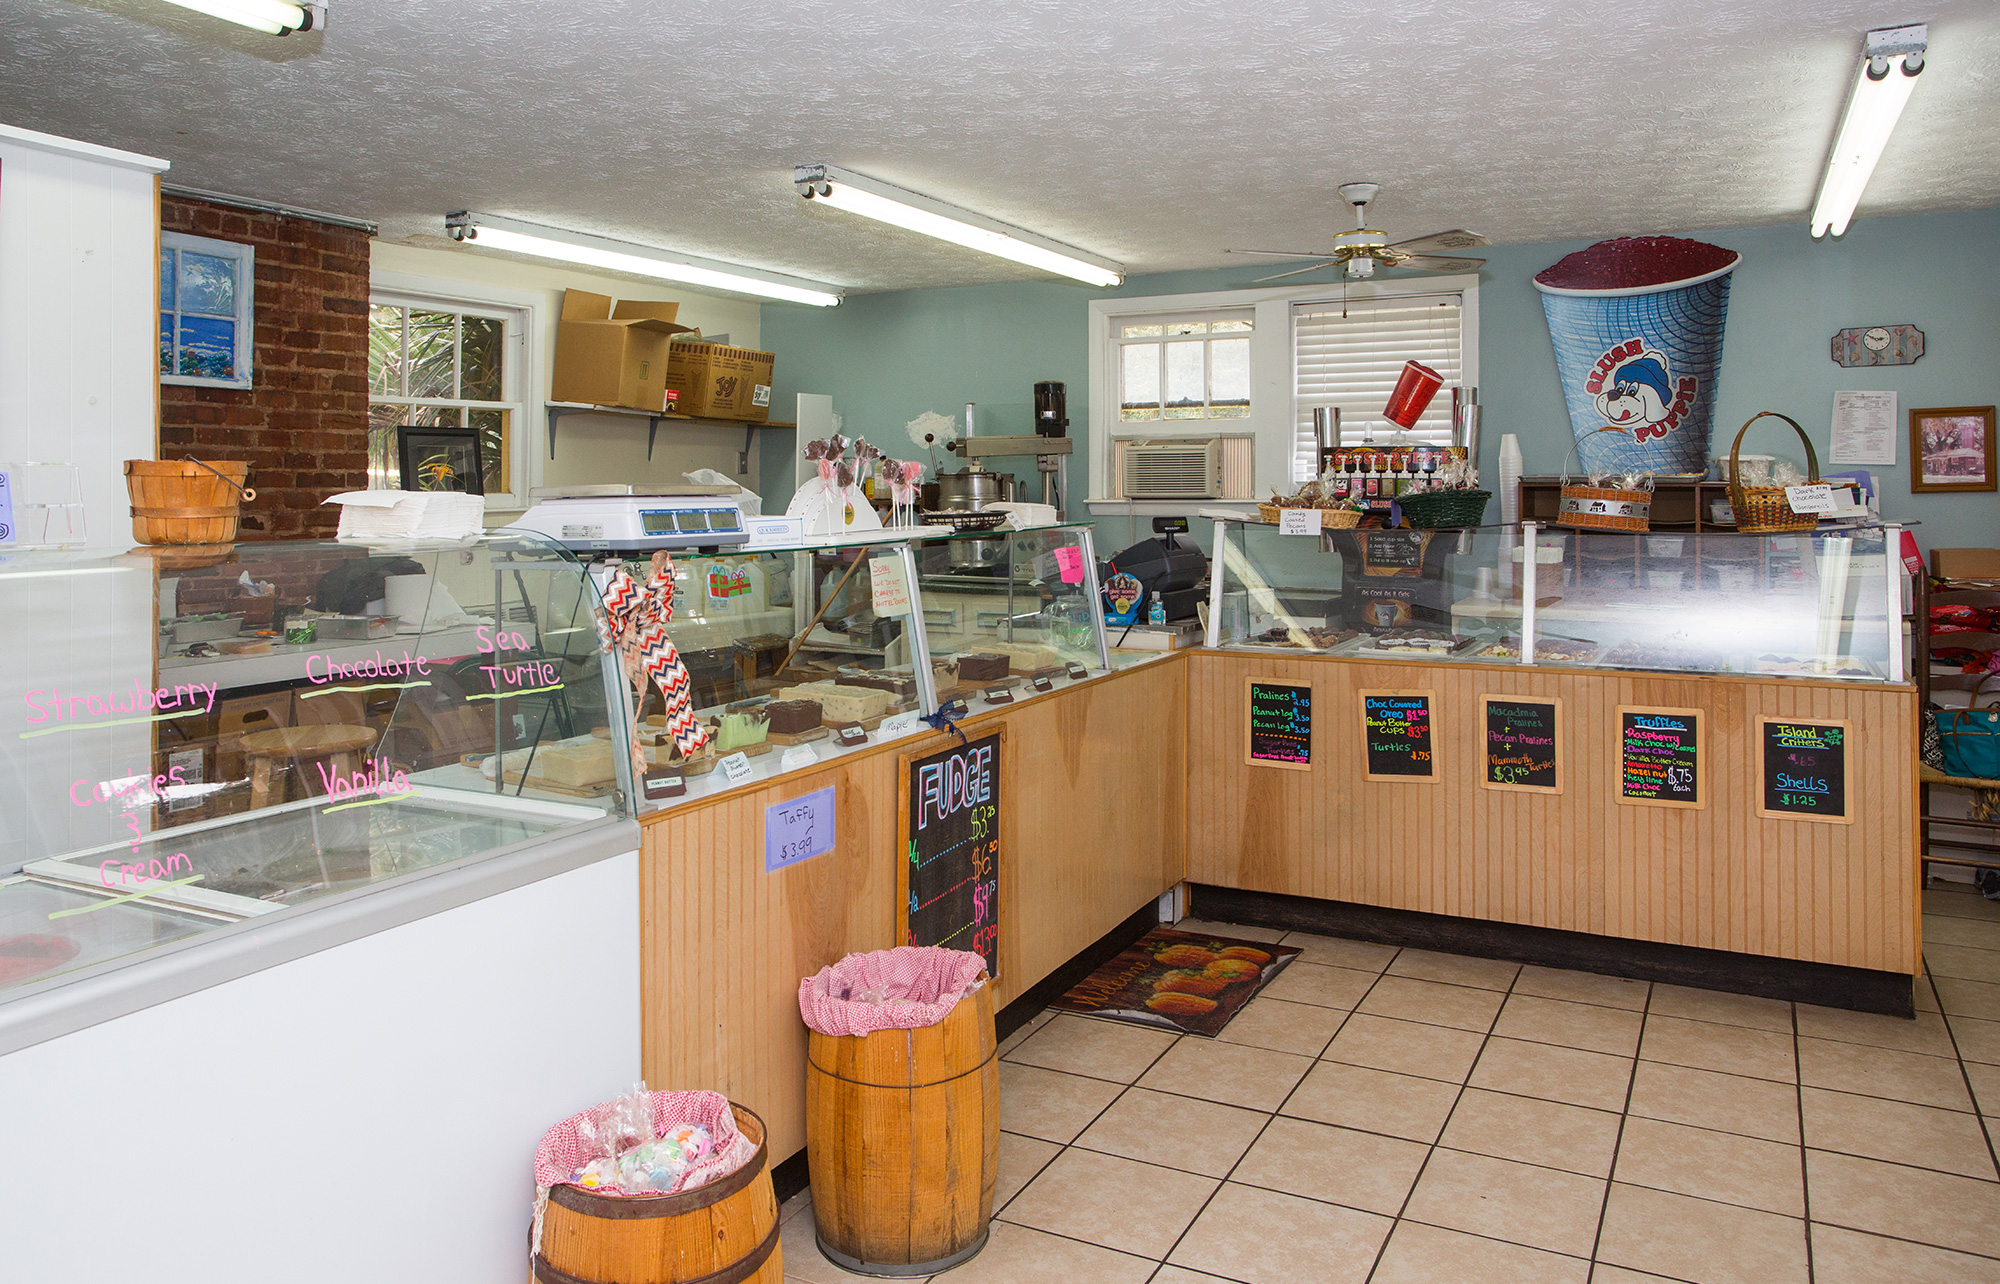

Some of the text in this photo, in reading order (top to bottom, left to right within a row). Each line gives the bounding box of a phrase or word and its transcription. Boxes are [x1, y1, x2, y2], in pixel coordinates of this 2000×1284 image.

[1586, 340, 1643, 394] SLUSH
[1335, 451, 1386, 466] SLUSH
[1371, 500, 1392, 509] SLUS
[475, 625, 531, 654] Sea
[305, 650, 432, 685] Chocolate
[478, 660, 561, 689] Turtle
[24, 677, 218, 724] Strawberry
[1253, 686, 1290, 701] Pralines
[1366, 698, 1423, 709] Choc Covered
[1252, 705, 1281, 717] Peanut
[1379, 709, 1404, 719] Oreo
[1253, 719, 1276, 728] Pecan
[1506, 717, 1543, 728] Pralines
[1633, 716, 1685, 728] Truffles
[1488, 730, 1554, 746] Pecan Pralines
[1627, 727, 1680, 747] Raspberry
[1776, 725, 1817, 739] Island
[1371, 742, 1412, 752] Turtles
[1626, 738, 1644, 747] Milk
[1644, 740, 1665, 748] Choc
[1781, 737, 1825, 748] Critters
[1627, 745, 1675, 756] Dark Choc
[1487, 753, 1533, 766] Mammoth
[1627, 767, 1668, 778] Hazel nut
[70, 765, 187, 807] Cookies
[316, 756, 414, 804] Vanilla
[1642, 783, 1660, 791] Choc
[1776, 772, 1828, 792] Shells
[918, 744, 992, 831] FUDGE
[1780, 793, 1816, 806] $1.25
[778, 805, 815, 836] Taffy
[779, 836, 813, 861] $3.99
[100, 852, 194, 888] Cream
